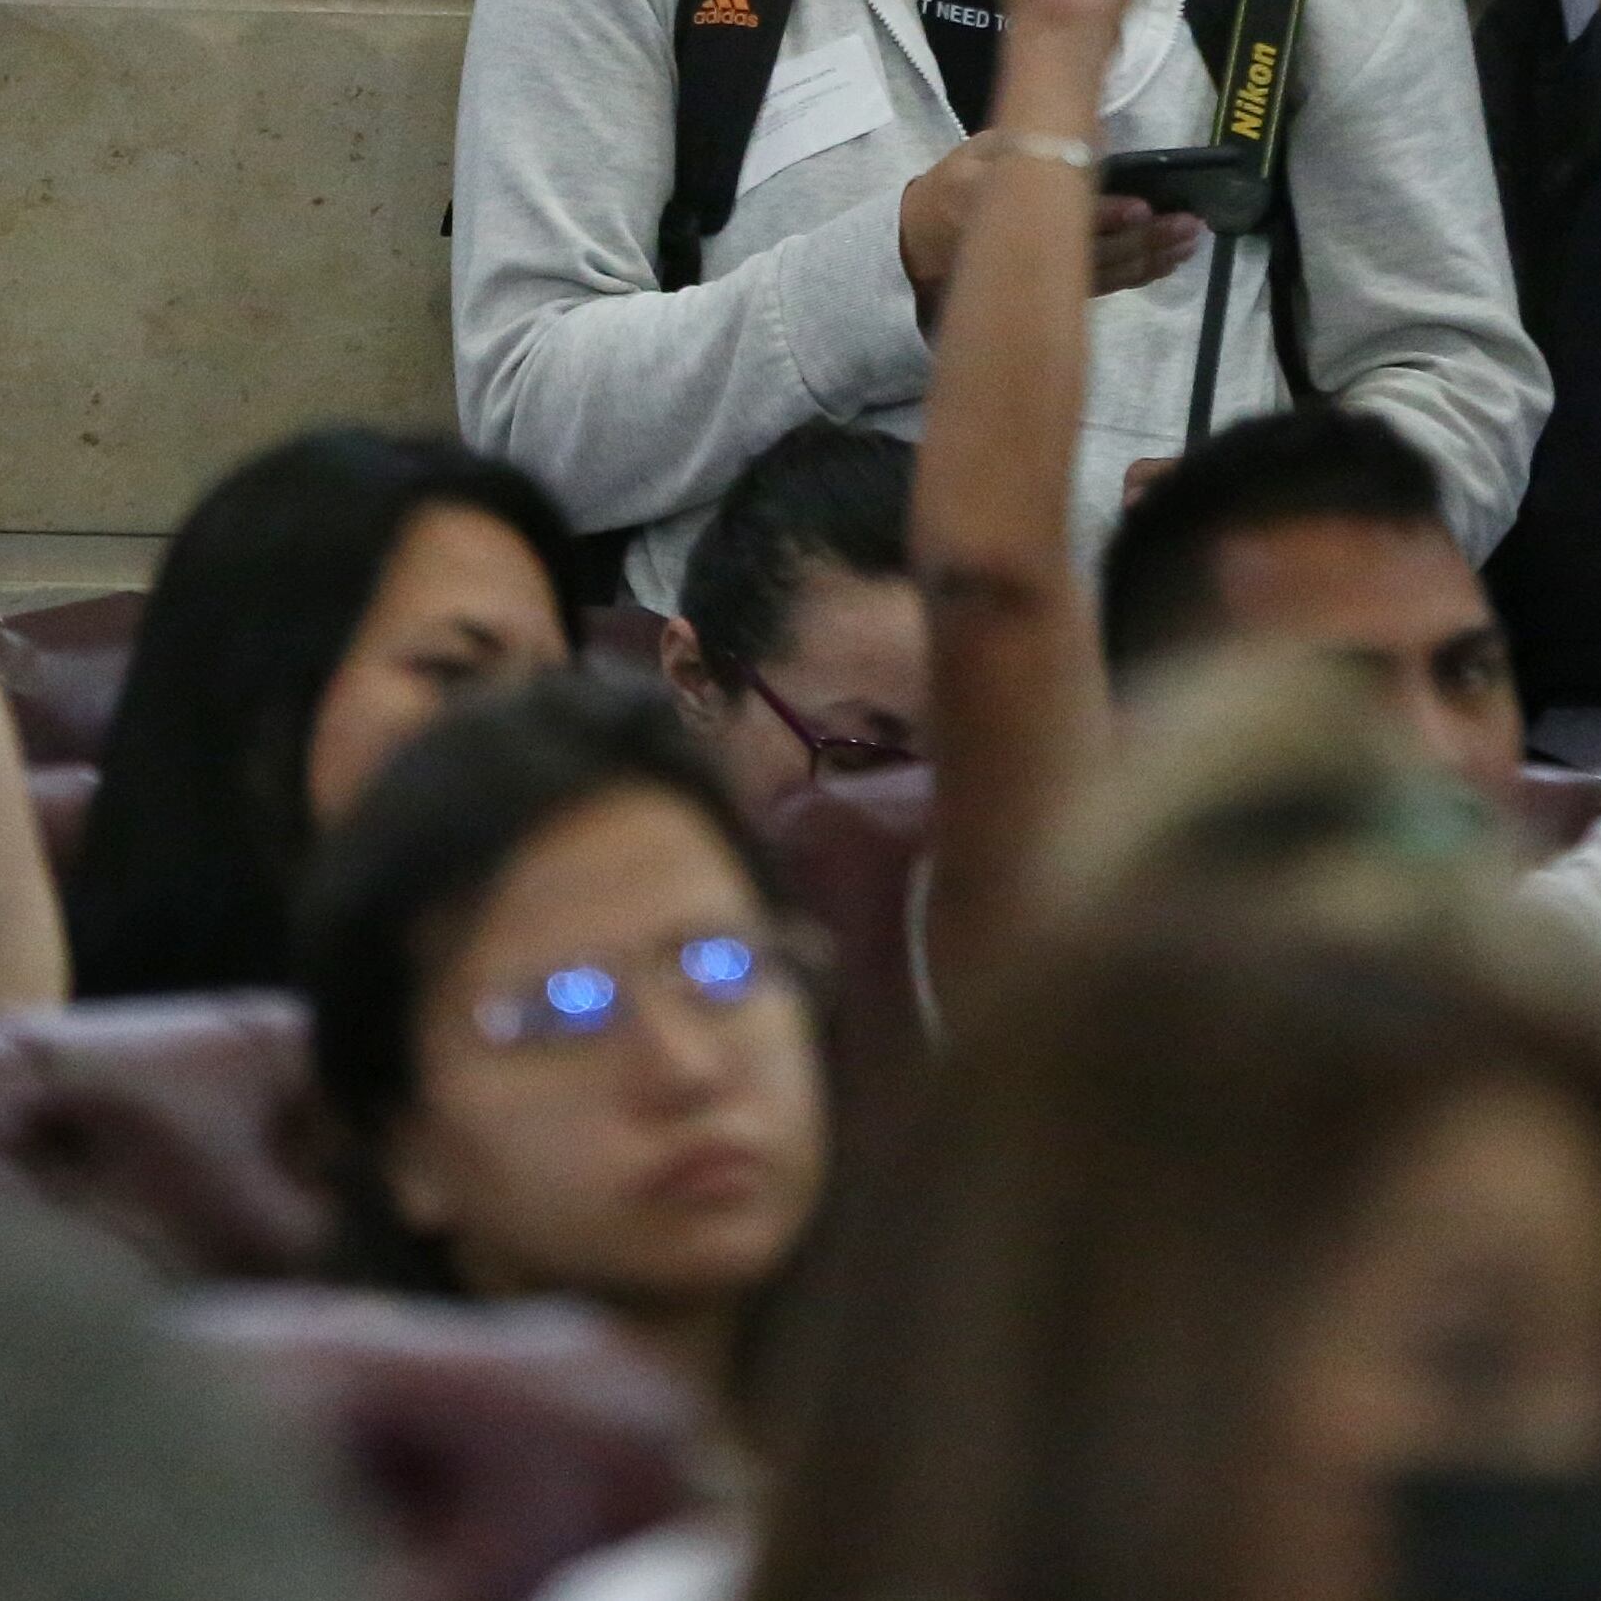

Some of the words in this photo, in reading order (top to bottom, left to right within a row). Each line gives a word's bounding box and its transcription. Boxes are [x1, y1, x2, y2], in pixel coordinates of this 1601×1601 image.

[693, 5, 759, 28] adidas
[936, 0, 990, 29] NEED
[1230, 41, 1277, 141] Nikon
